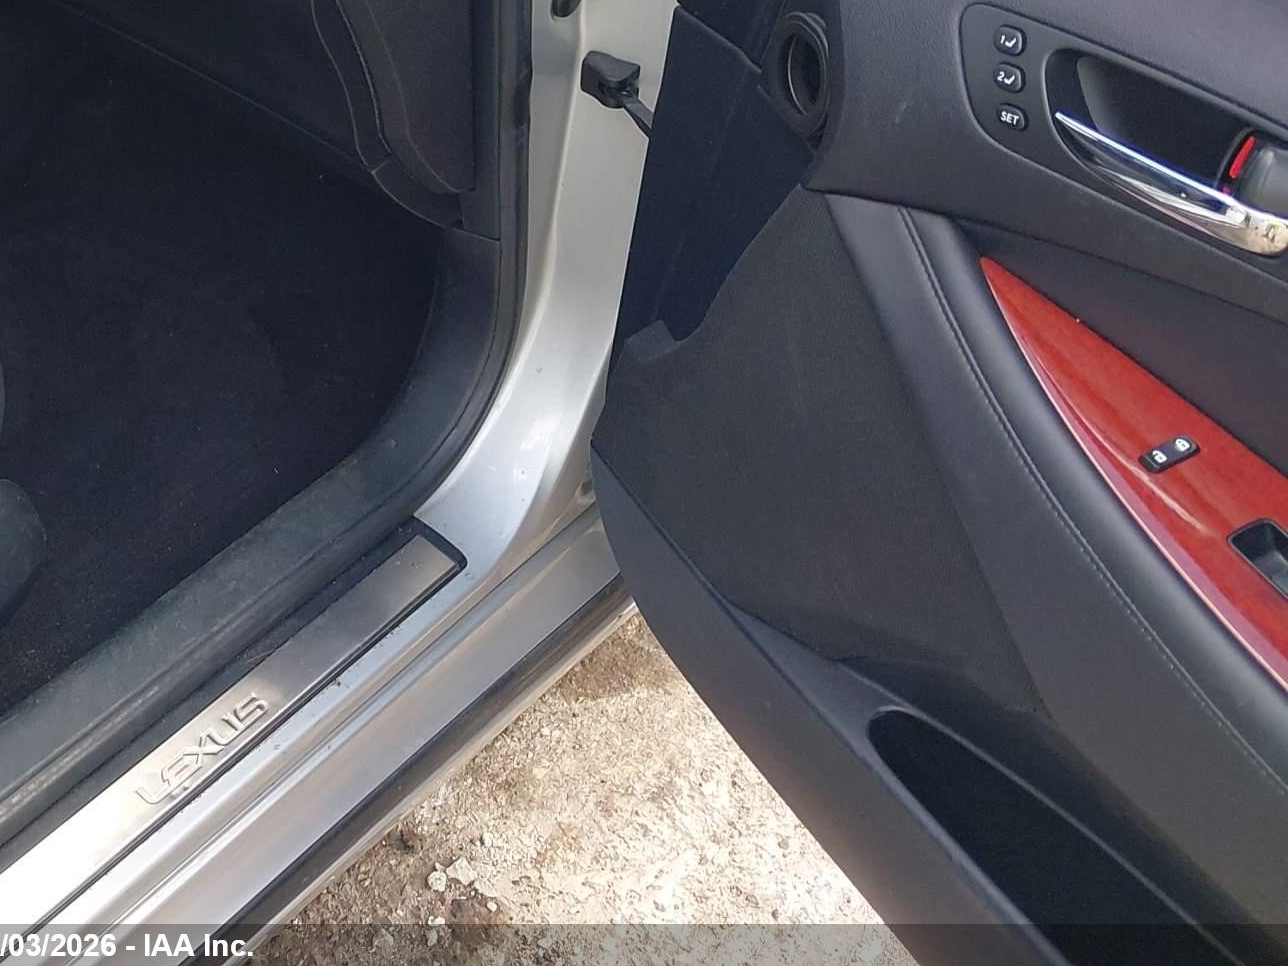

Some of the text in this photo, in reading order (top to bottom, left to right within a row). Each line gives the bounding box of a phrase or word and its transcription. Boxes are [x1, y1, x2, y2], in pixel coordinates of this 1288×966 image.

[1000, 35, 1006, 44] 1
[997, 71, 1005, 81] 2
[1000, 111, 1020, 125] SET
[135, 692, 269, 805] LEXUS
